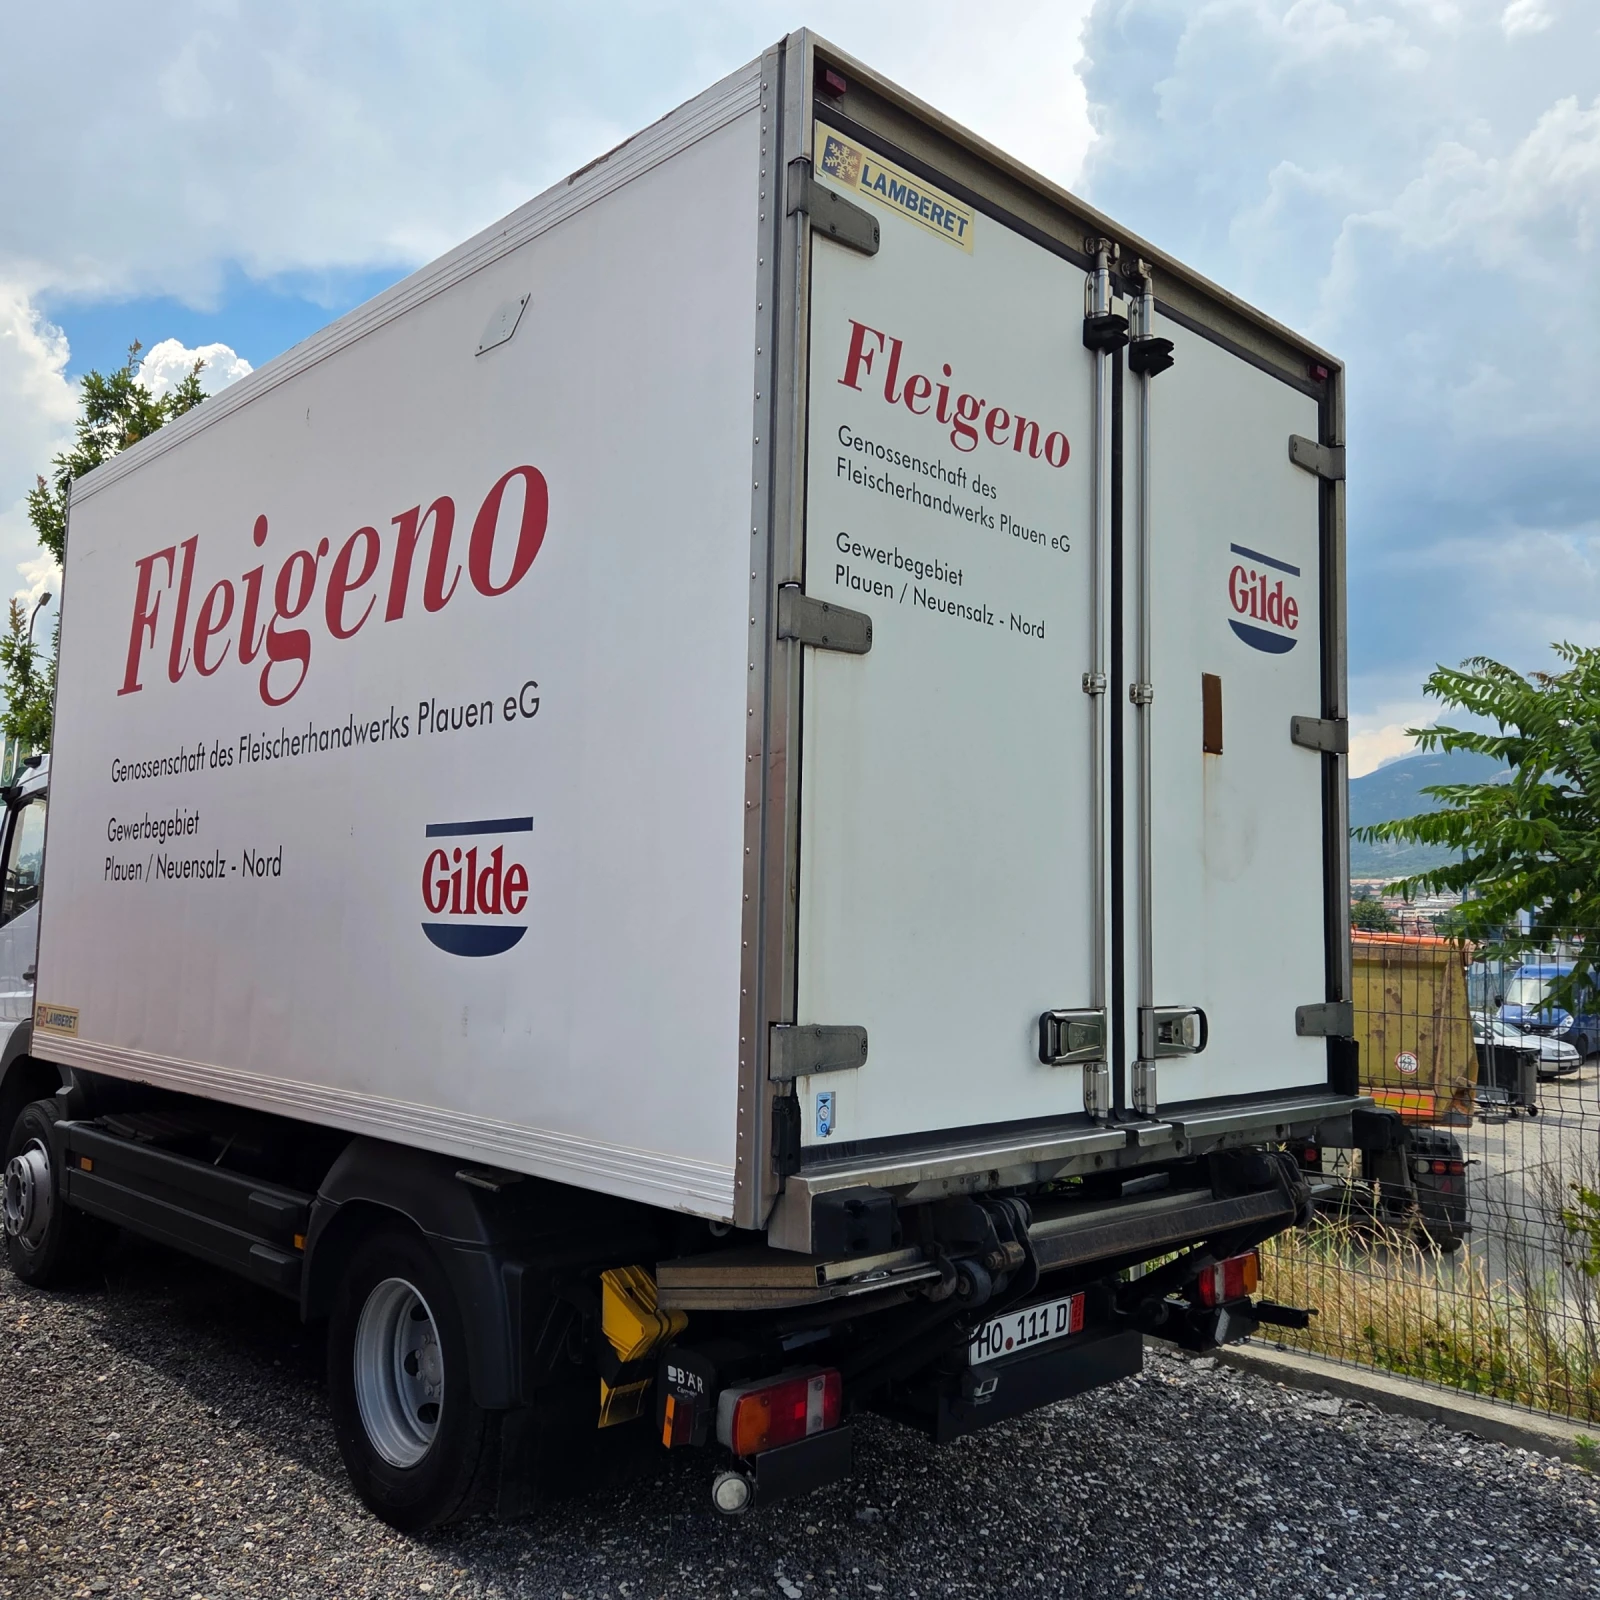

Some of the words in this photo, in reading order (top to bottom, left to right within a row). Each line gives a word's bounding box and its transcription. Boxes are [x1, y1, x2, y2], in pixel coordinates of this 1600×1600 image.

[861, 164, 968, 237] LAMBERET
[837, 319, 1071, 468] Fleigeno
[838, 424, 967, 489] Genossenschaft
[972, 473, 998, 501] des
[837, 456, 995, 530] Fleischerhandwerks
[999, 512, 1047, 548] Plauen
[1051, 534, 1072, 554] eG
[117, 465, 549, 707] Fleigeno
[836, 532, 964, 586] Gewerbegebiet
[836, 564, 894, 599] Plauen
[913, 586, 996, 627] Neuensalz
[1009, 612, 1046, 640] Nord
[1229, 565, 1298, 630] Gilde
[111, 742, 206, 784] Genossenschaft
[209, 739, 235, 770] des
[238, 705, 410, 765] Fleischerhandwerks
[417, 697, 494, 736] Plauen
[503, 680, 541, 723] eG
[107, 808, 200, 843] Gewerbegebiet
[104, 855, 142, 882] Plauen
[155, 849, 227, 881] Neuensalz
[242, 844, 283, 879] Nord
[421, 844, 530, 916] Gilde
[676, 1367, 704, 1395] BÄR
